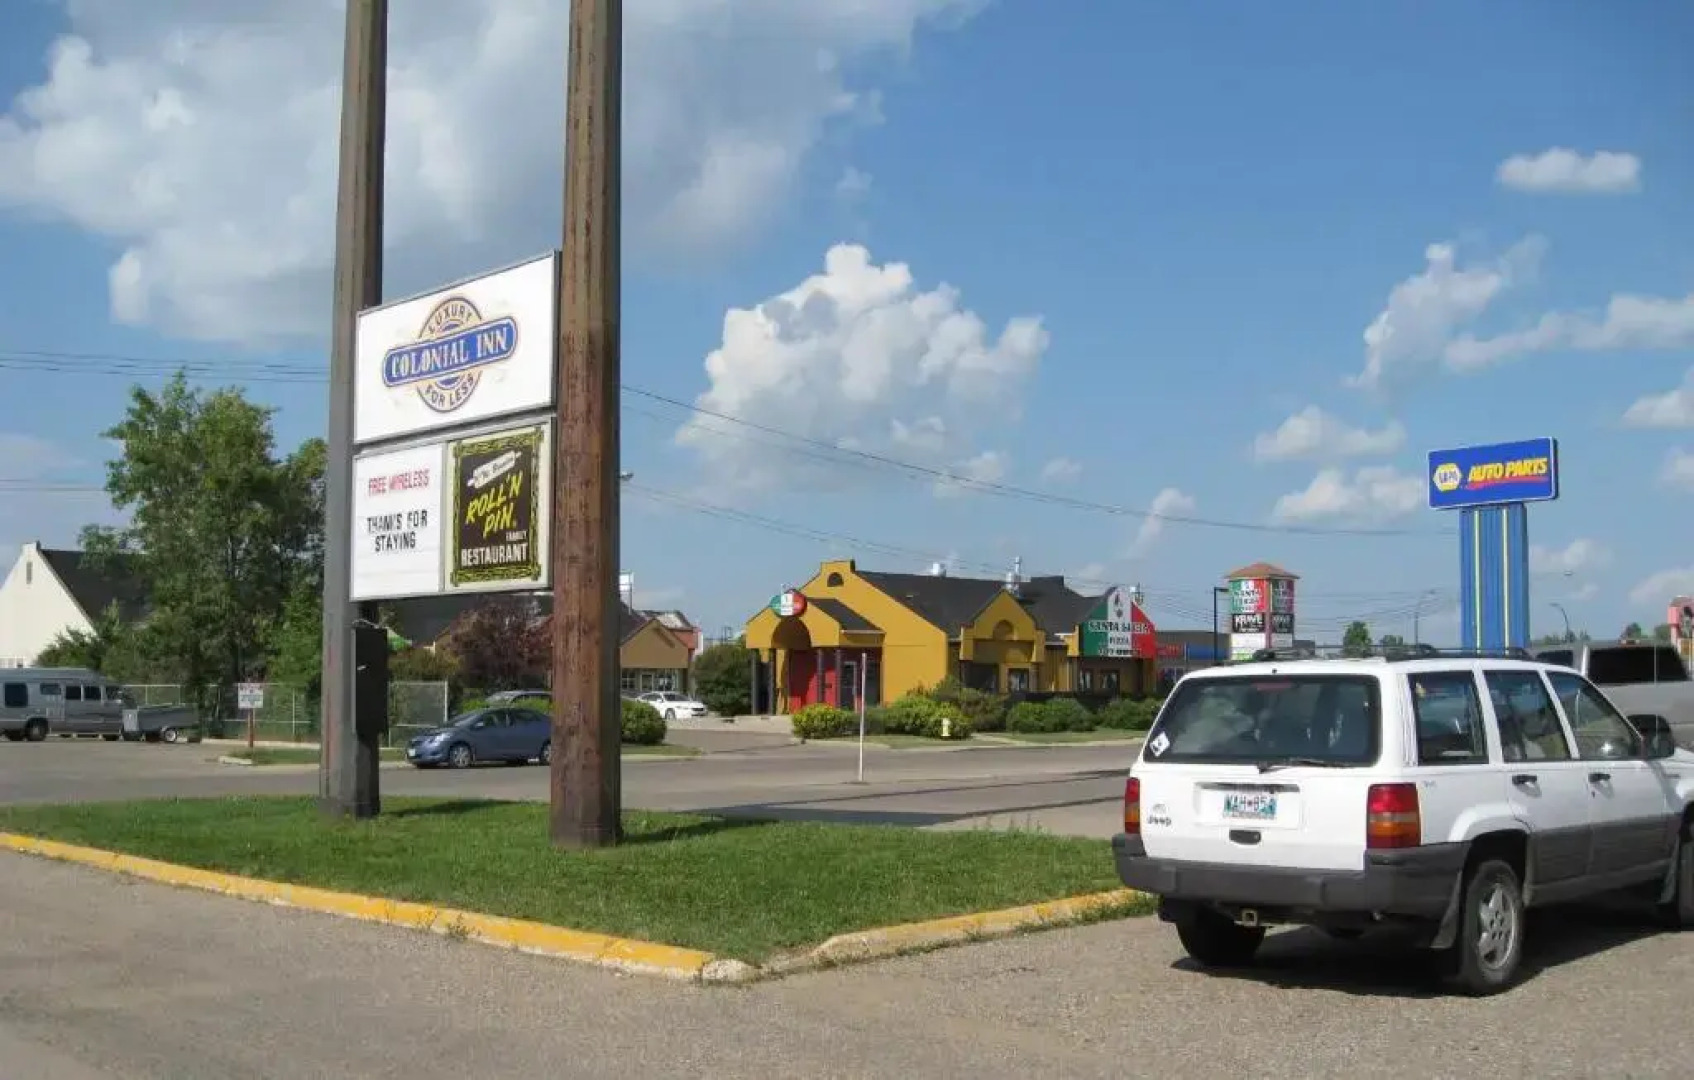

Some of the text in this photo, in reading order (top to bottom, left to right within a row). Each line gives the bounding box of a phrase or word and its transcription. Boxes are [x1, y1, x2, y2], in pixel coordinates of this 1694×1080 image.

[427, 303, 473, 334] LUXURY
[391, 326, 508, 378] COLONIAL INN
[425, 373, 474, 406] FOR LESS
[368, 468, 430, 496] FREE WIRELESS
[1468, 457, 1548, 482] AUTO PARTS
[465, 470, 524, 524] ROLL'N
[407, 509, 428, 528] FOR
[375, 531, 416, 552] STAYING
[461, 543, 529, 566] RESTAURANT
